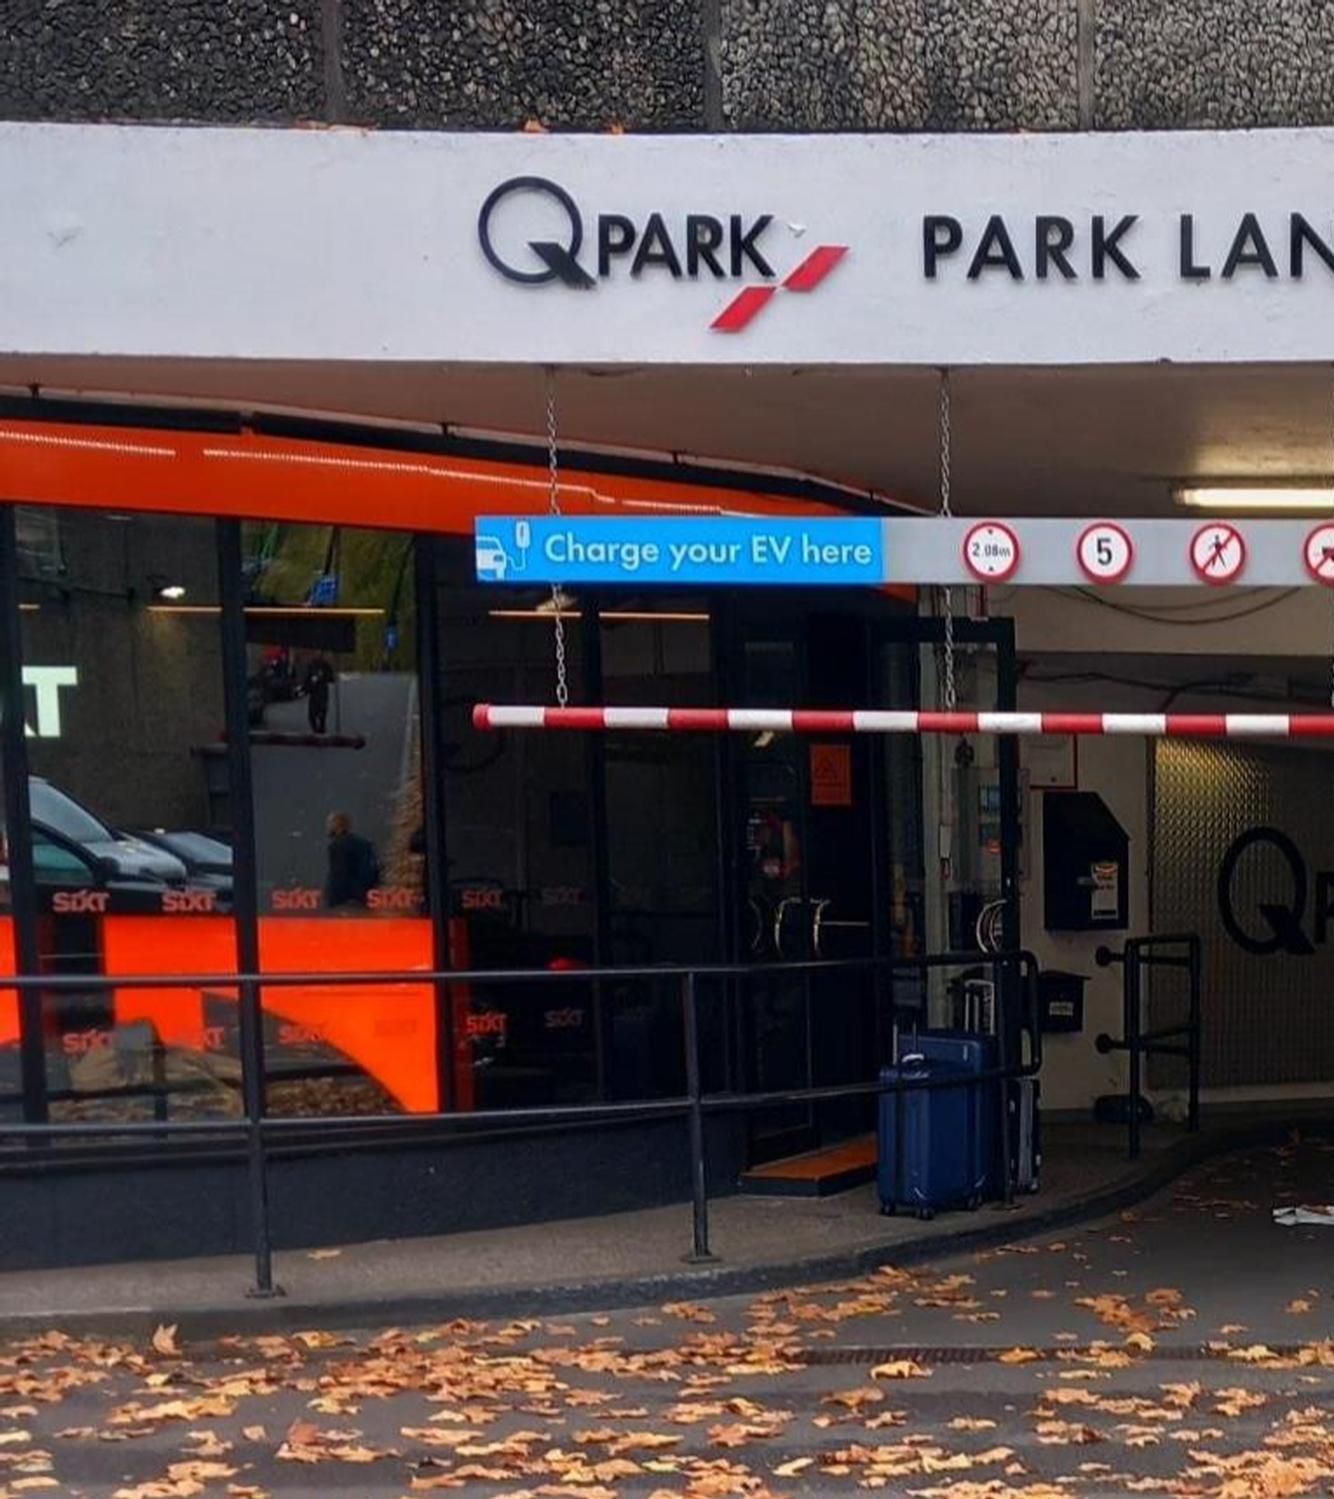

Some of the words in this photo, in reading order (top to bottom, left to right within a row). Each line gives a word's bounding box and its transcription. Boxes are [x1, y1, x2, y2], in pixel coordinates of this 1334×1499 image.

[922, 214, 1142, 280] PARK
[545, 533, 659, 571] Charge
[668, 541, 741, 571] your
[752, 536, 792, 564] EV
[802, 534, 872, 564] here
[1096, 537, 1113, 566] 5
